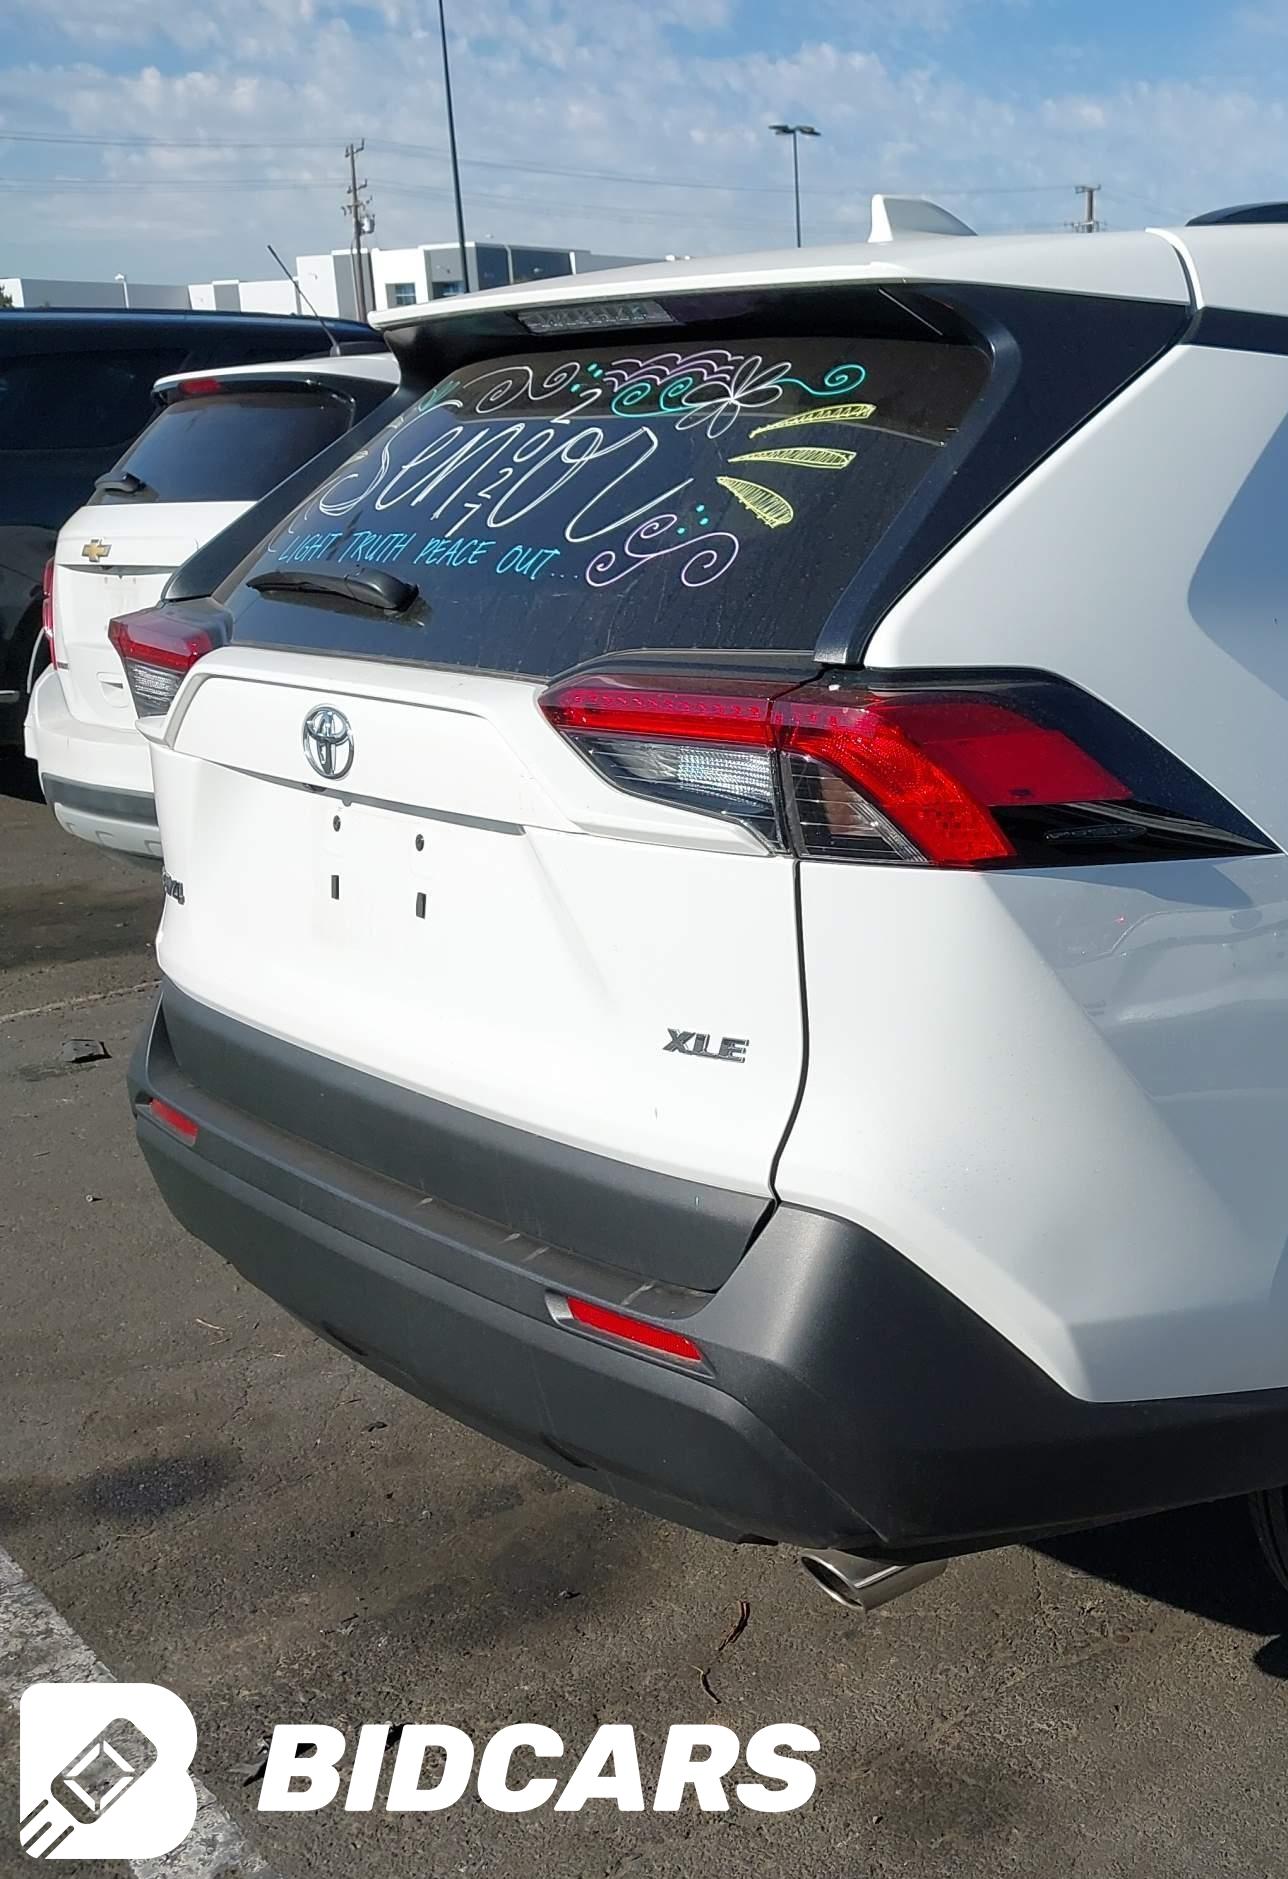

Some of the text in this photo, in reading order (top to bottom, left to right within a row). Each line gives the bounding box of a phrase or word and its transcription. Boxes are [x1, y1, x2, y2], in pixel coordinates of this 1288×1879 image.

[277, 531, 344, 565] LIGHT
[337, 530, 417, 564] TRUTH
[412, 536, 497, 567] PEACE
[661, 1027, 751, 1064] XLE
